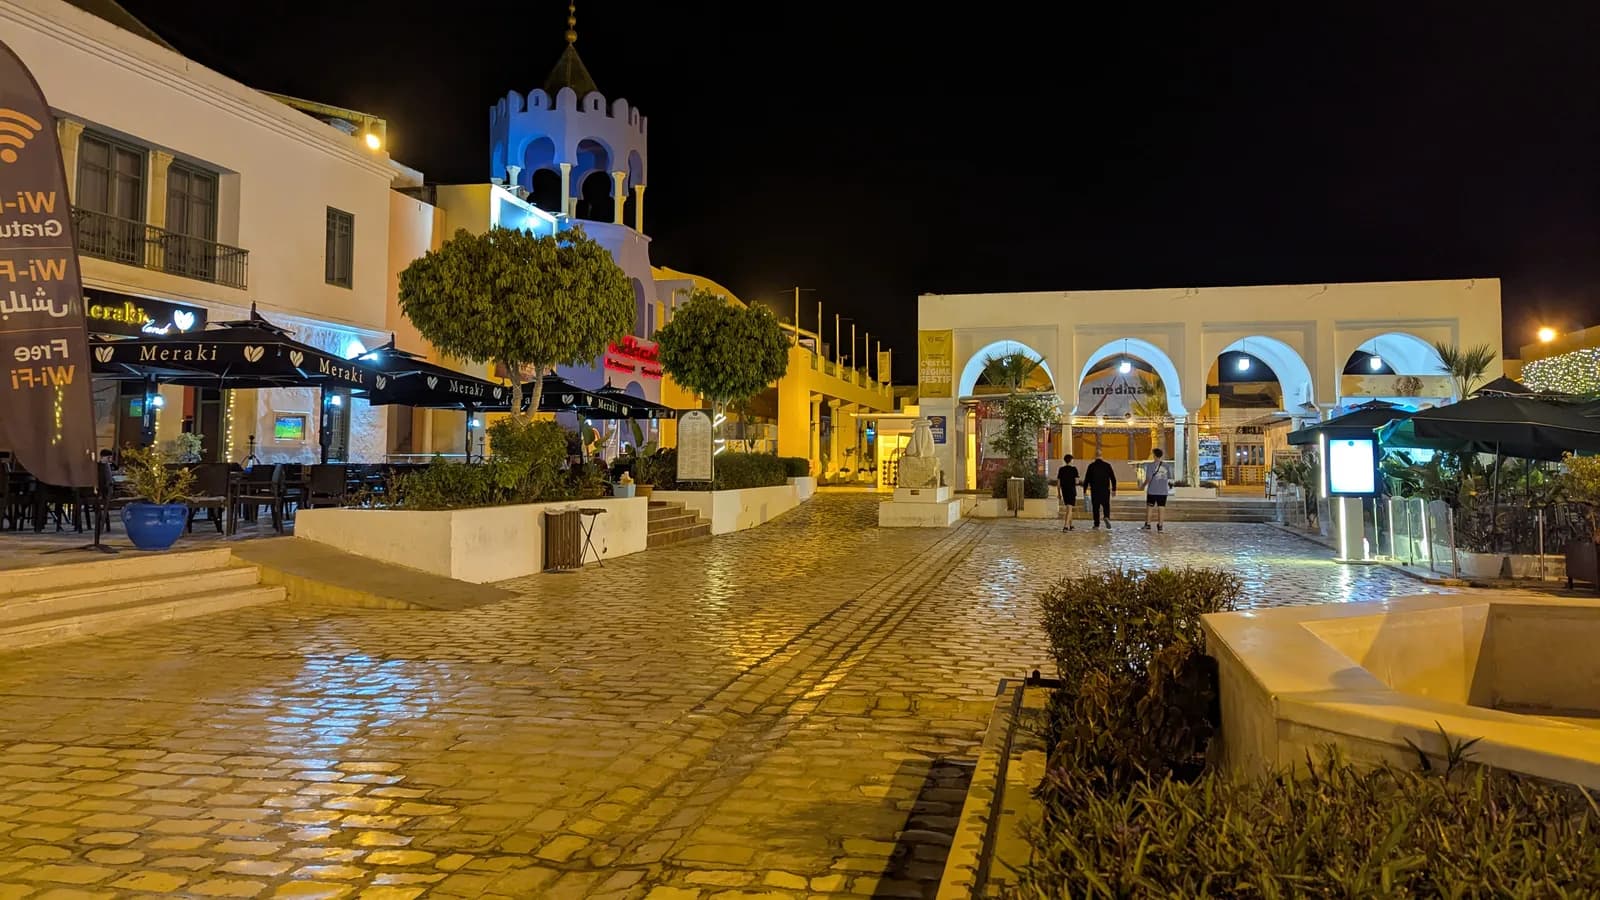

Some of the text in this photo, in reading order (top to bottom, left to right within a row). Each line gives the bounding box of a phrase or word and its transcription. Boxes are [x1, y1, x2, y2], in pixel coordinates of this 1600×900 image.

[140, 345, 218, 361] Meraki
[319, 357, 363, 384] Meraki
[449, 380, 484, 397] Meraki
[598, 399, 618, 413] Meraki
